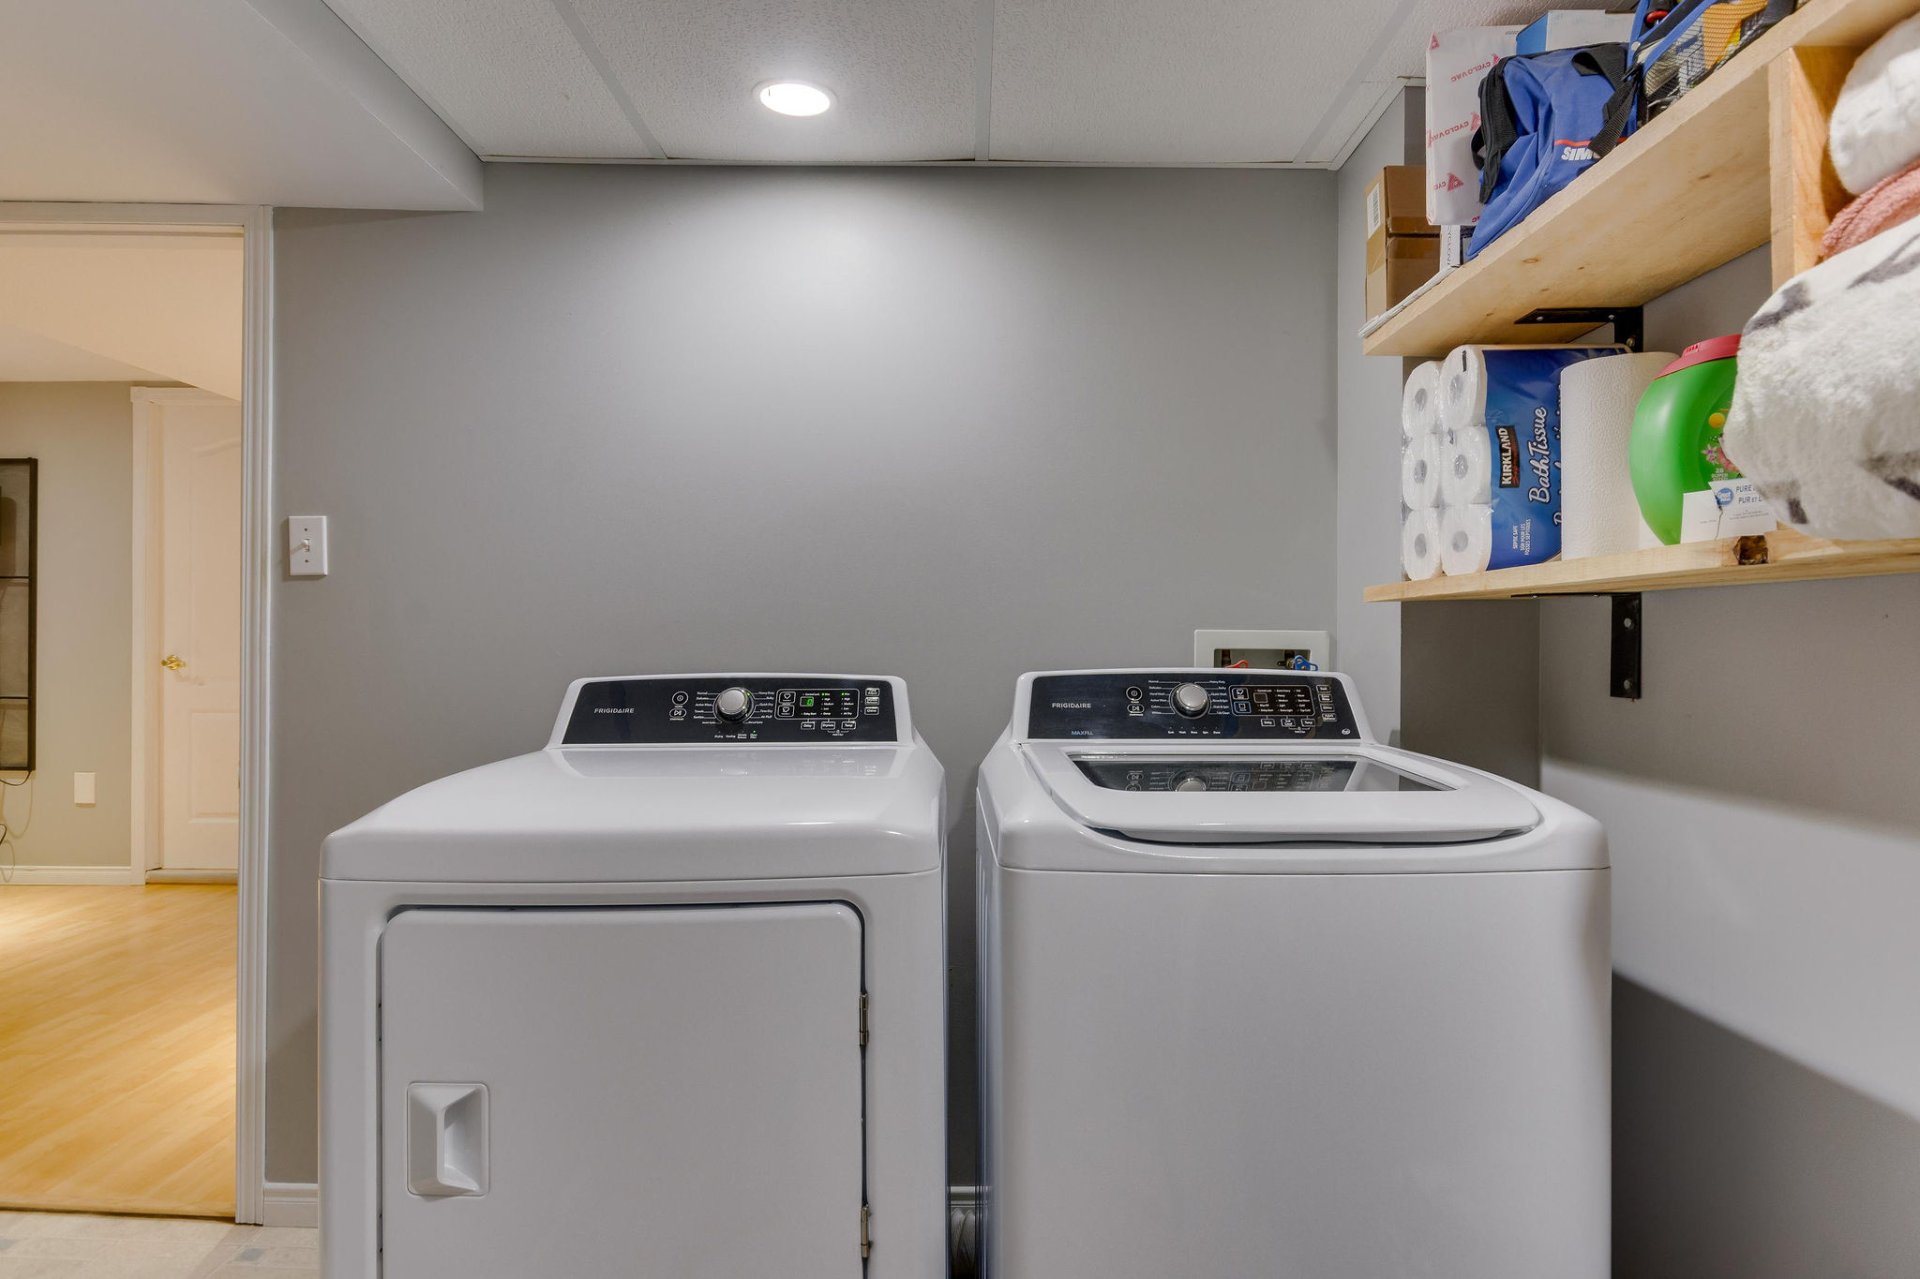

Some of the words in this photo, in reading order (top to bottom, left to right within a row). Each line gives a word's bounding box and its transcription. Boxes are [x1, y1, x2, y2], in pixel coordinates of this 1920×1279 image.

[1450, 61, 1492, 82] CYCLOVAC
[1528, 406, 1550, 456] Tissue
[1499, 427, 1512, 486] KIRKLAND
[1528, 455, 1551, 503] Bath
[1735, 484, 1752, 493] PURE
